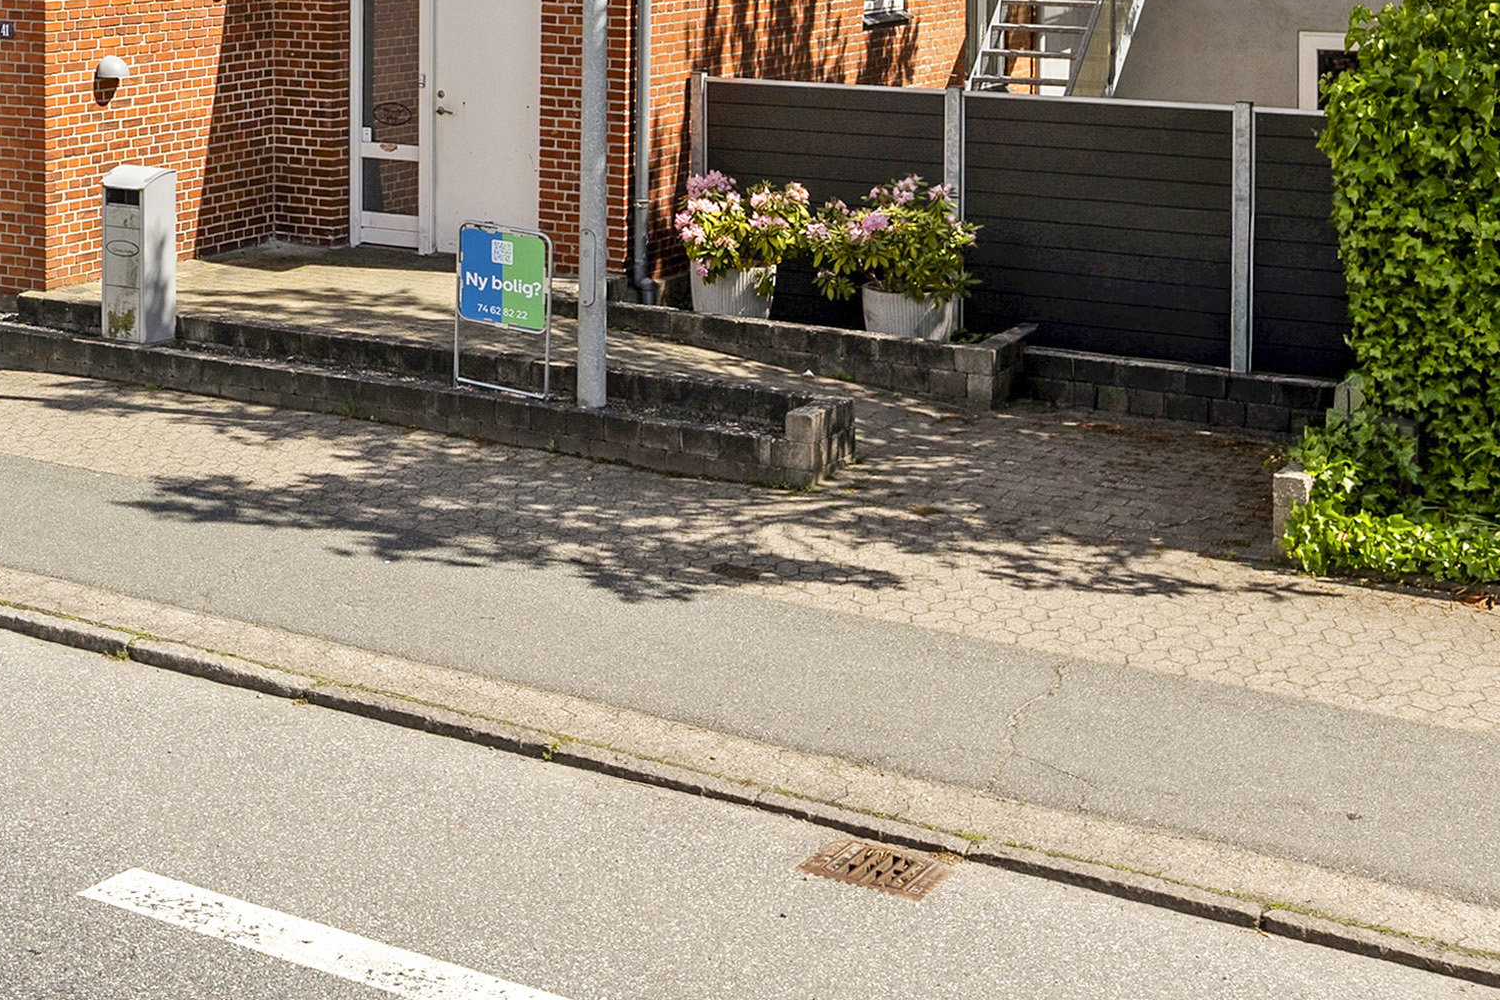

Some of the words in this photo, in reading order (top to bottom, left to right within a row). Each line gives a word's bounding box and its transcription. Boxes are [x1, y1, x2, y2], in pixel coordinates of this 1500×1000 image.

[0, 23, 10, 37] 41
[465, 270, 488, 291] Ny
[491, 275, 542, 299] bolig?
[477, 303, 489, 313] 74
[489, 305, 502, 316] 62
[502, 307, 515, 318] 82
[516, 310, 528, 320] 22
